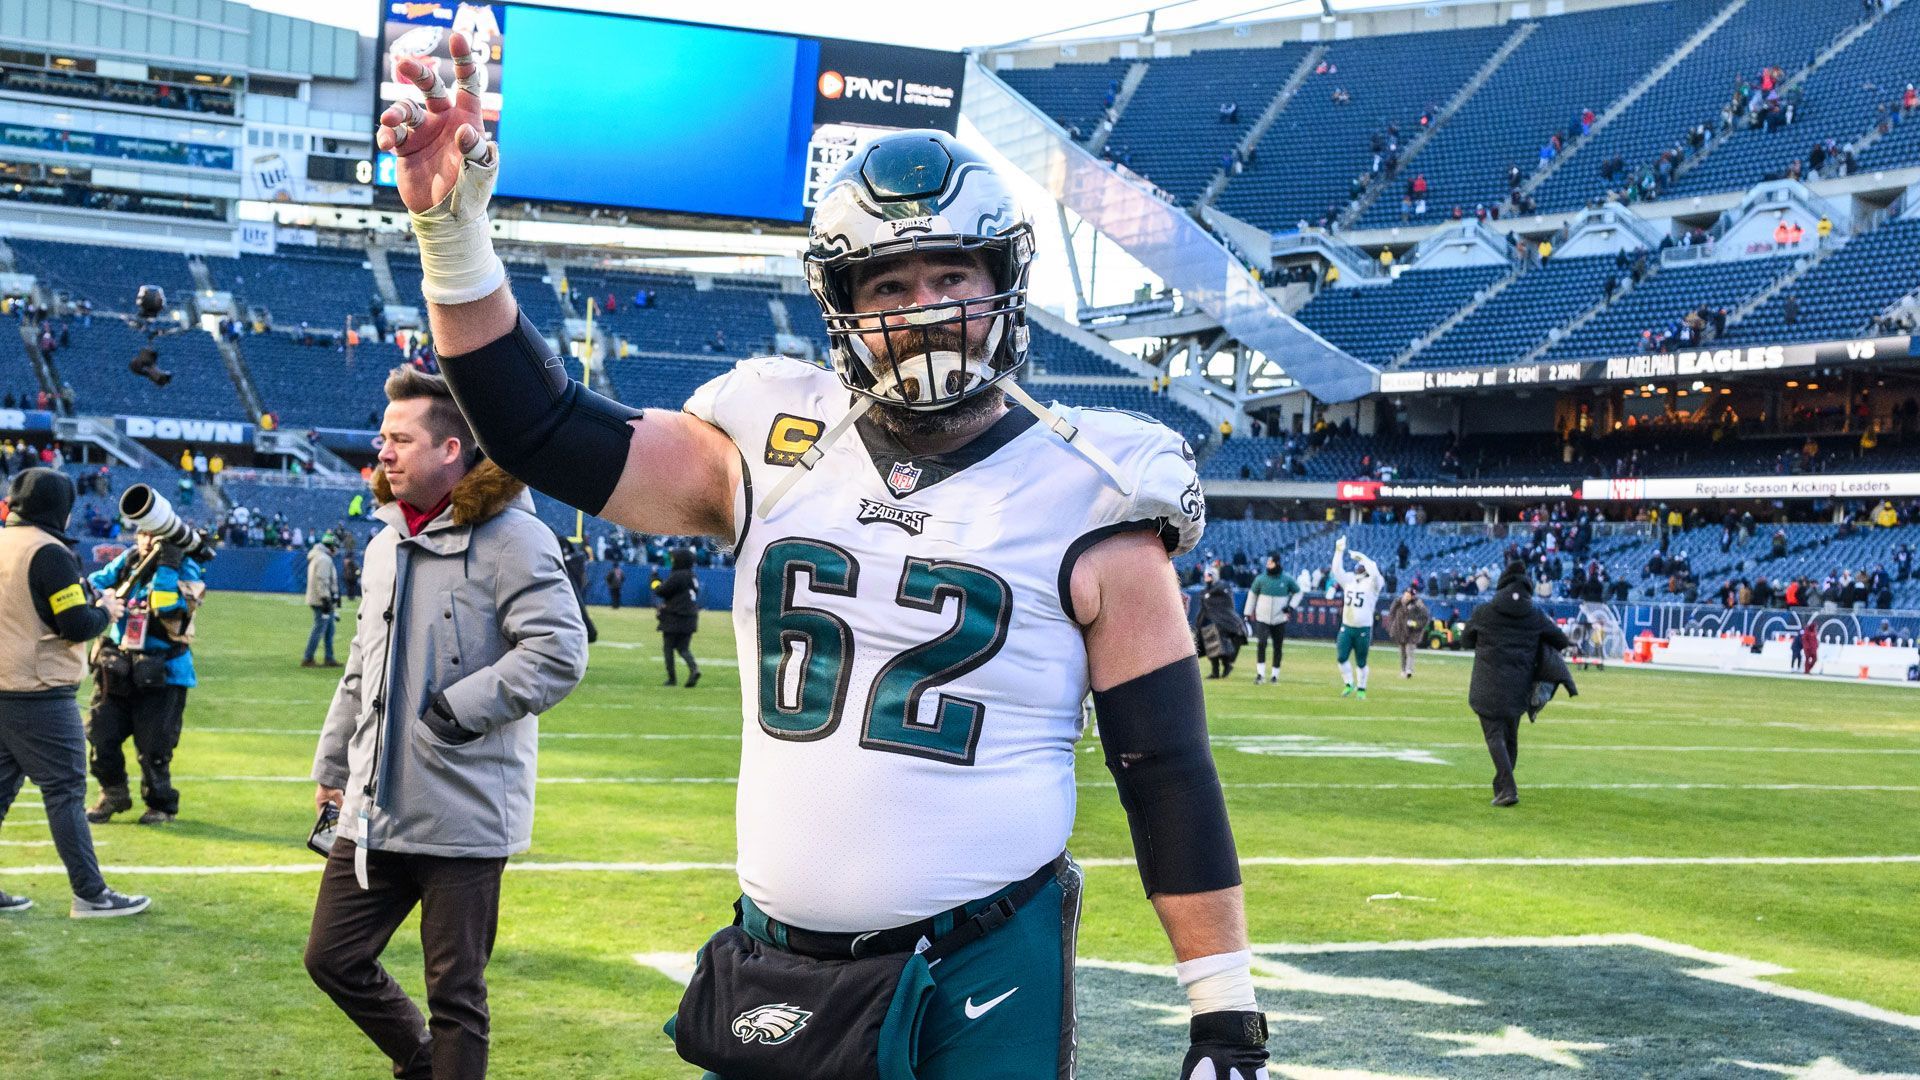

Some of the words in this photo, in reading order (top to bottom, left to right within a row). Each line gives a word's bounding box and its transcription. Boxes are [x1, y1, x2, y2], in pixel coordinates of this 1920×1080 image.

[845, 76, 895, 102] PNC
[890, 217, 932, 236] EAGLES
[1846, 340, 1876, 359] VS
[1606, 353, 1676, 380] PHILADELPHIA
[1677, 346, 1784, 375] EAGLES
[125, 416, 243, 444] DOWN
[770, 417, 819, 454] C
[891, 472, 913, 489] NFL
[1393, 485, 1417, 499] shape
[1417, 485, 1431, 497] the
[1431, 485, 1457, 497] future
[1457, 485, 1467, 497] of
[1466, 485, 1481, 497] real
[1504, 484, 1516, 497] for
[1522, 484, 1546, 497] better
[1696, 482, 1740, 496] Regular
[1744, 480, 1788, 494] Season
[1792, 480, 1837, 496] Kicking
[1841, 479, 1891, 492] Leaders
[856, 498, 933, 537] EAGLES
[1345, 590, 1364, 608] 55
[755, 536, 1013, 766] 62
